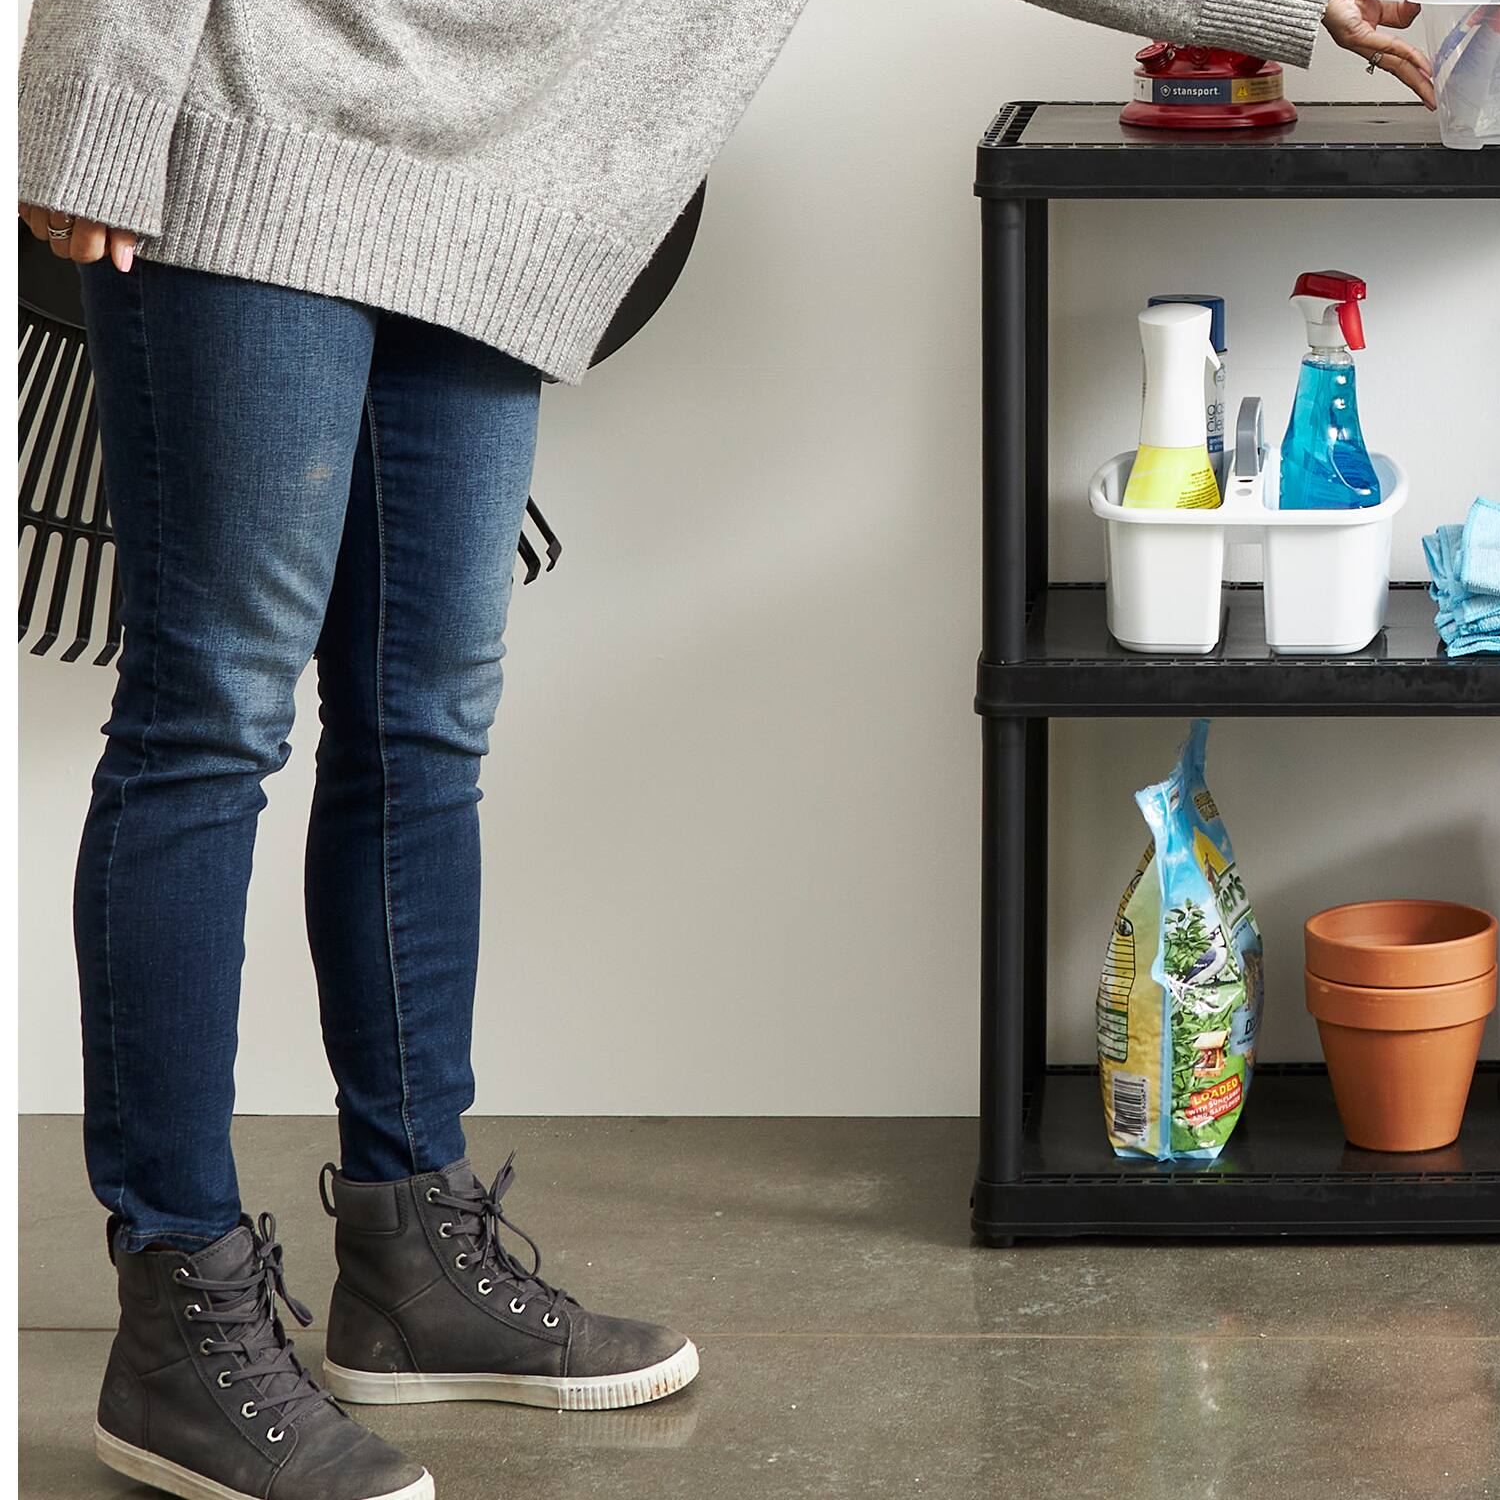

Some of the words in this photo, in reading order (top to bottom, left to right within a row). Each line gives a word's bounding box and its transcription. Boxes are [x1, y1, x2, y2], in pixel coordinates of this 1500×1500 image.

[1172, 86, 1219, 98] stansport
[1193, 1077, 1238, 1106] LOADED
[1187, 1103, 1208, 1116] WITH
